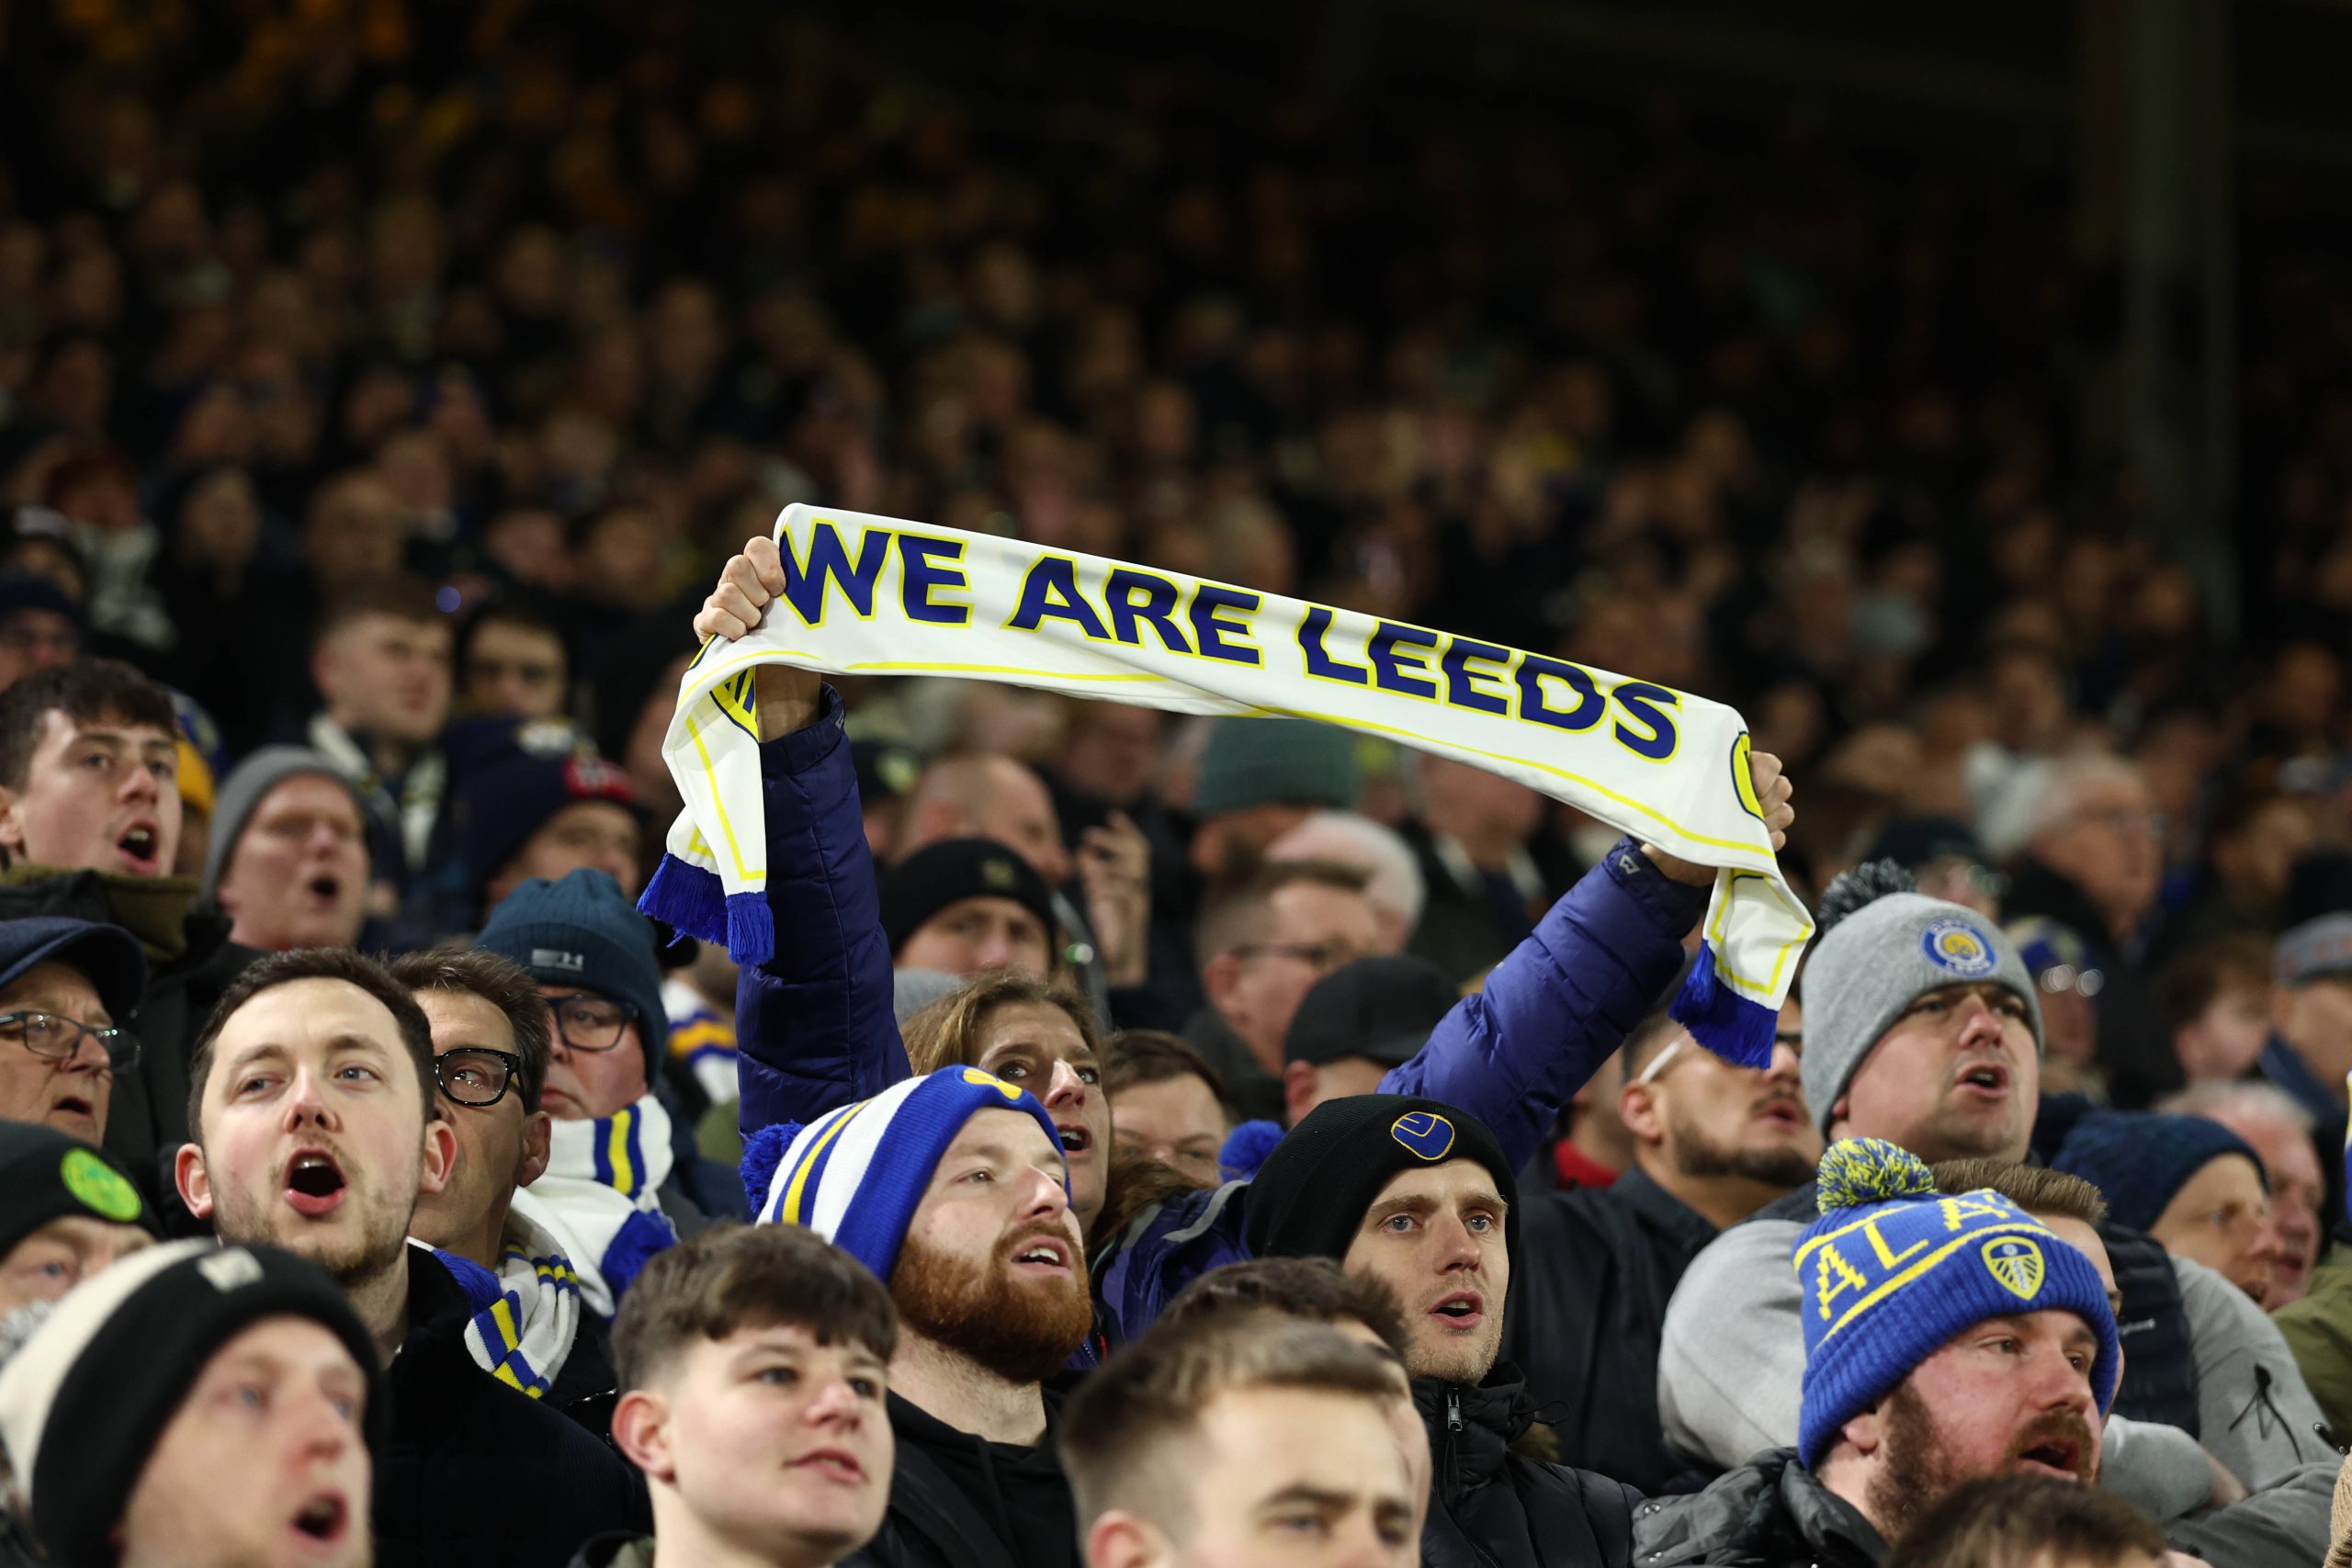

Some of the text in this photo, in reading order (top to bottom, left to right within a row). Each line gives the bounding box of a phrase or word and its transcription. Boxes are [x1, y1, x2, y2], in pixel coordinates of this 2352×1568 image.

[777, 518, 1682, 763] WE ARE LEEDS
